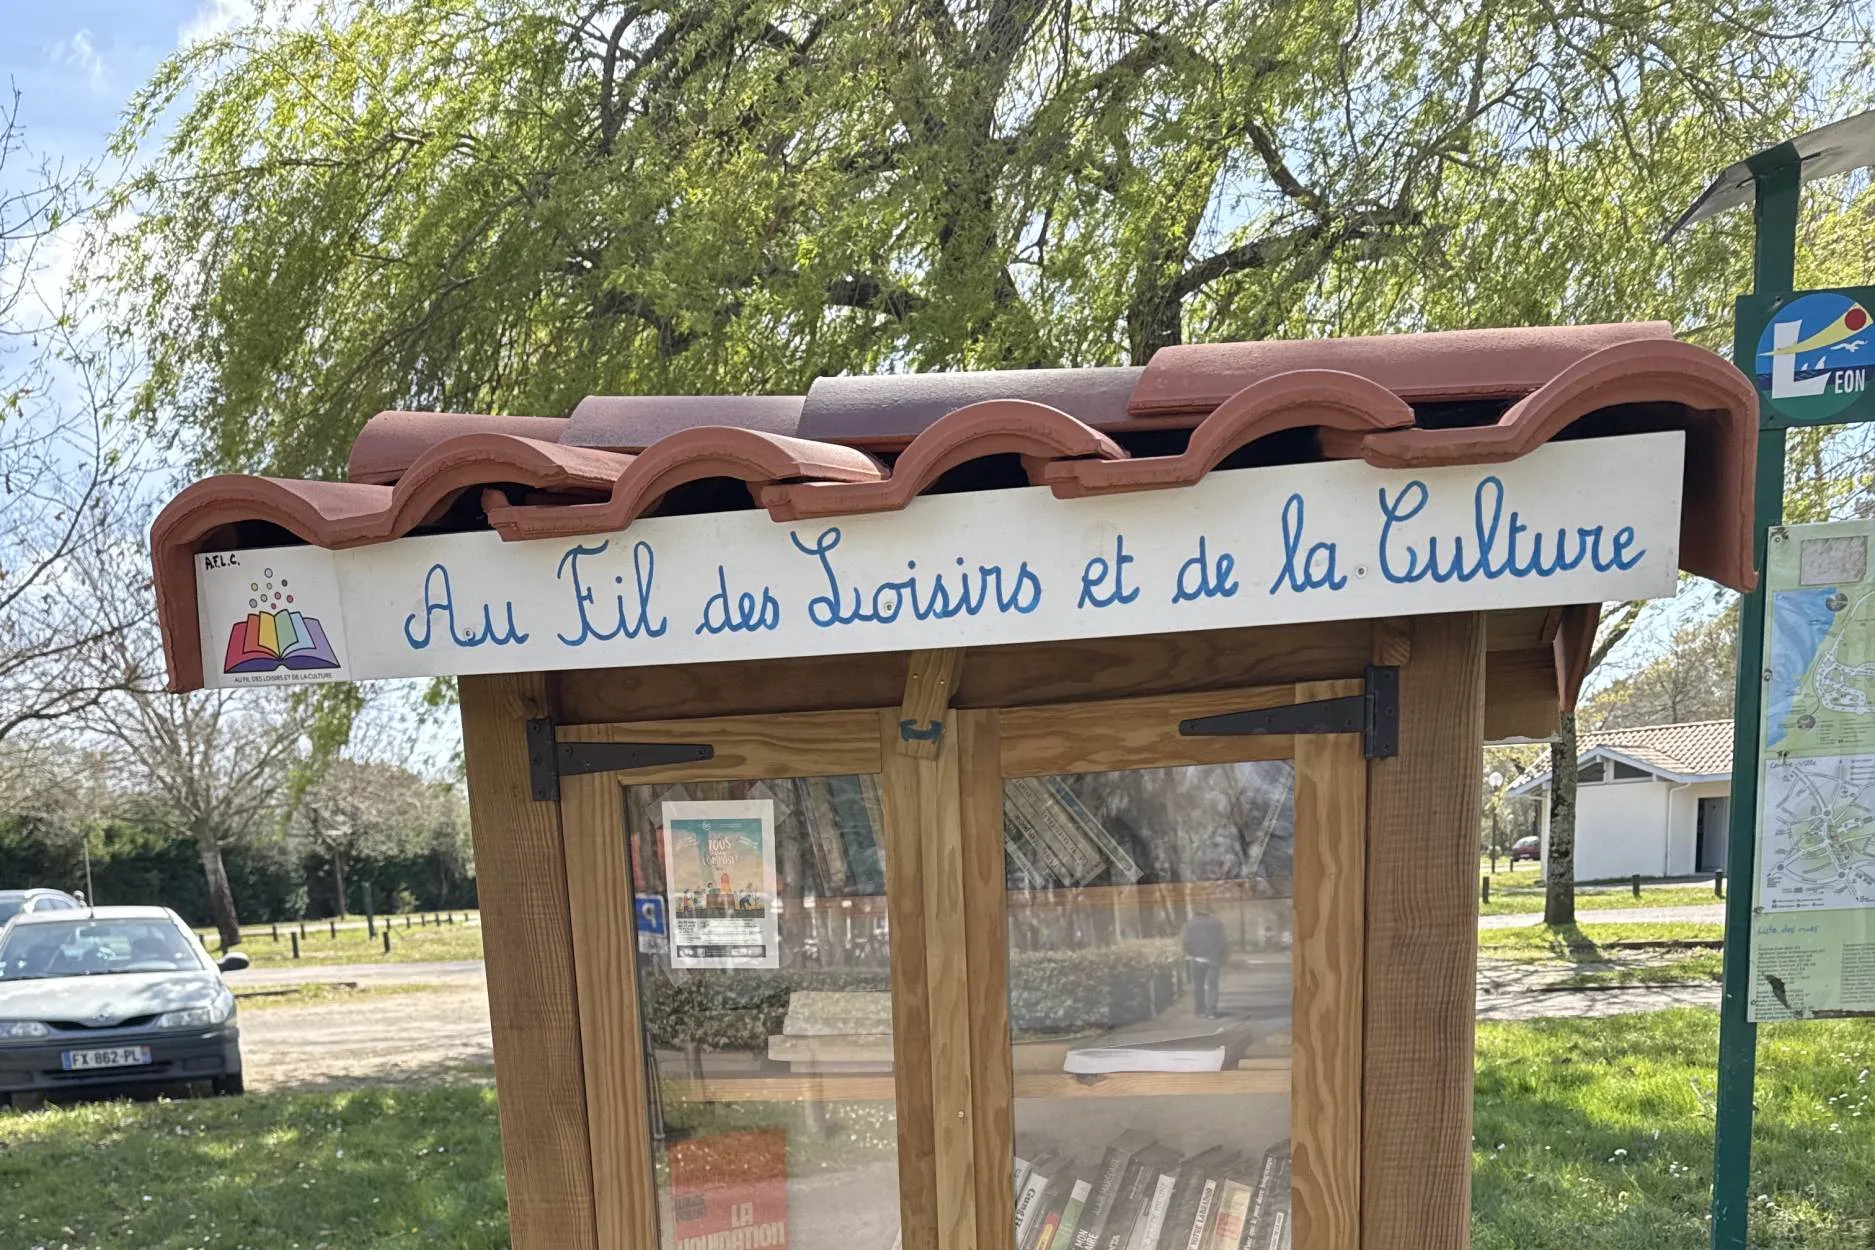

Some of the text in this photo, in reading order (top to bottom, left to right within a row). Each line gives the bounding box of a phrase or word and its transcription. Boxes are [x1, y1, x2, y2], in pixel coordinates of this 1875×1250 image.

[204, 553, 241, 571] A.F.L.C.
[404, 475, 1646, 650] Au Fil des Loisirs et de la Culture
[307, 672, 332, 680] CULTURE
[731, 1202, 753, 1228] LA
[1074, 1228, 1088, 1247] MON
[1189, 1224, 1203, 1246] VOTRE
